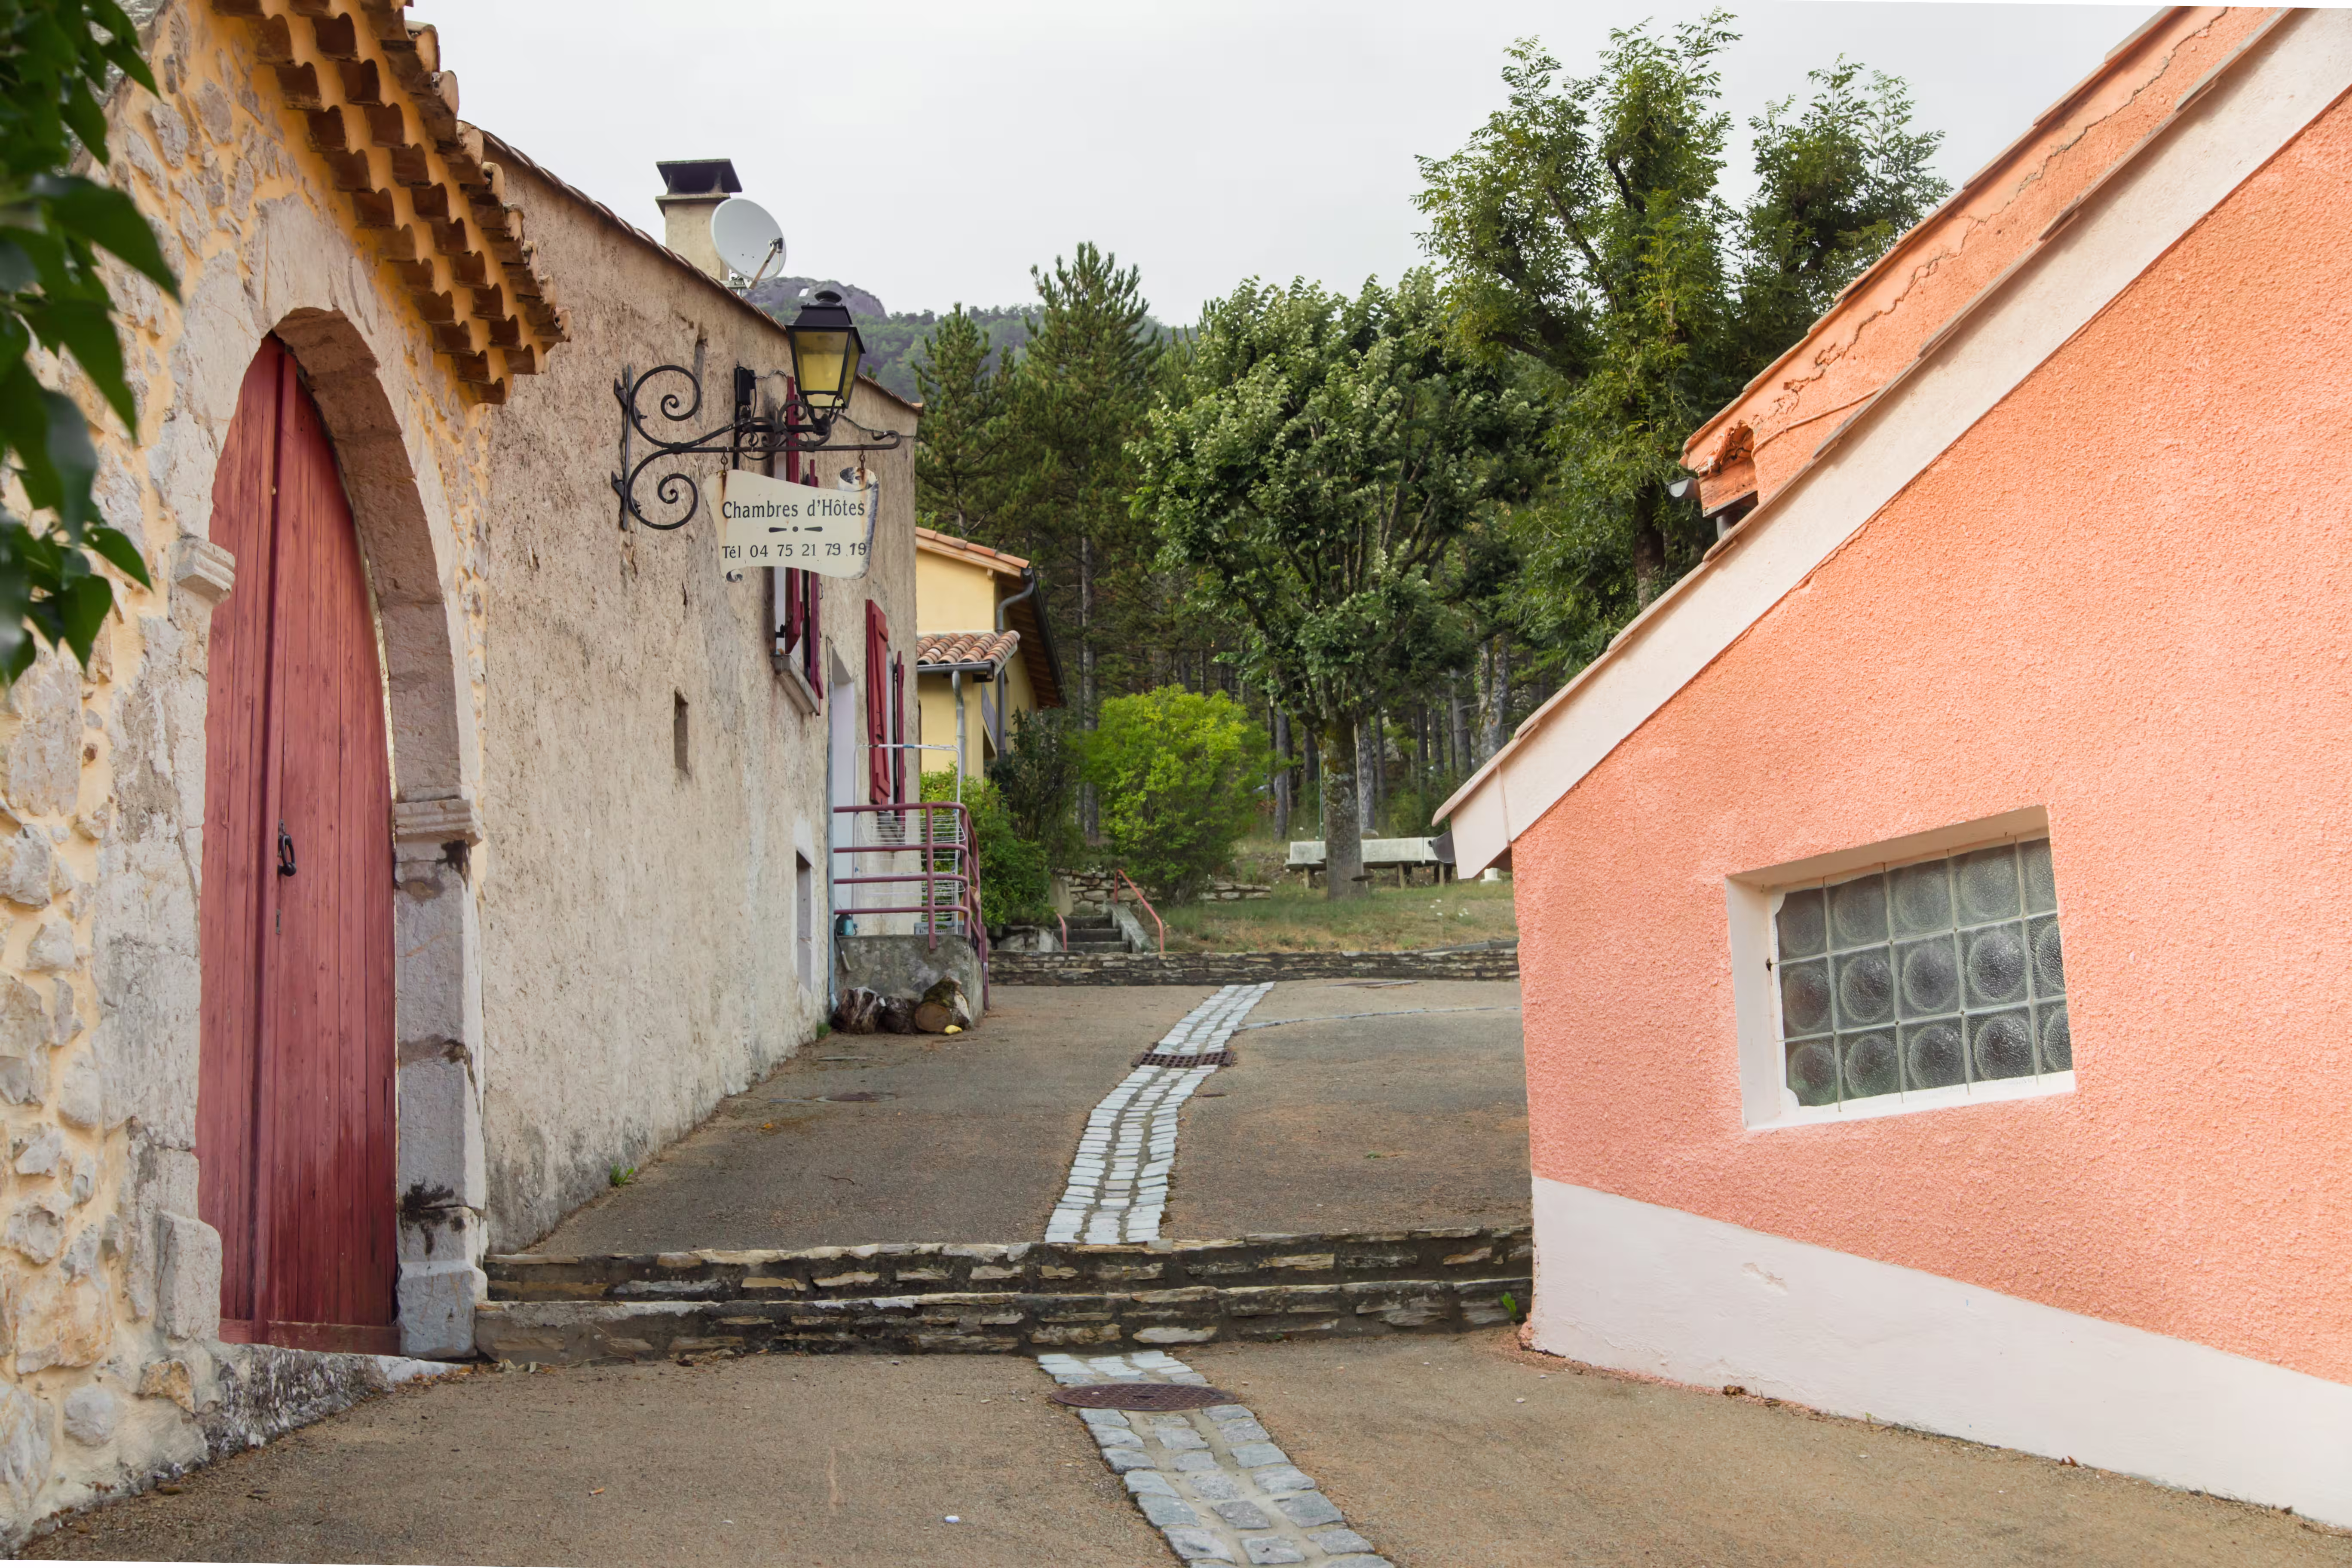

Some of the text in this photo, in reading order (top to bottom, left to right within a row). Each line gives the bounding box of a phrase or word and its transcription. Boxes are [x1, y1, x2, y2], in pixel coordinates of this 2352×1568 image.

[722, 499, 865, 518] Chambres d'Hôtes
[722, 545, 741, 558] Tél
[750, 545, 769, 557] 04
[777, 544, 793, 557] 75
[802, 543, 816, 556] 21
[825, 543, 841, 556] 79
